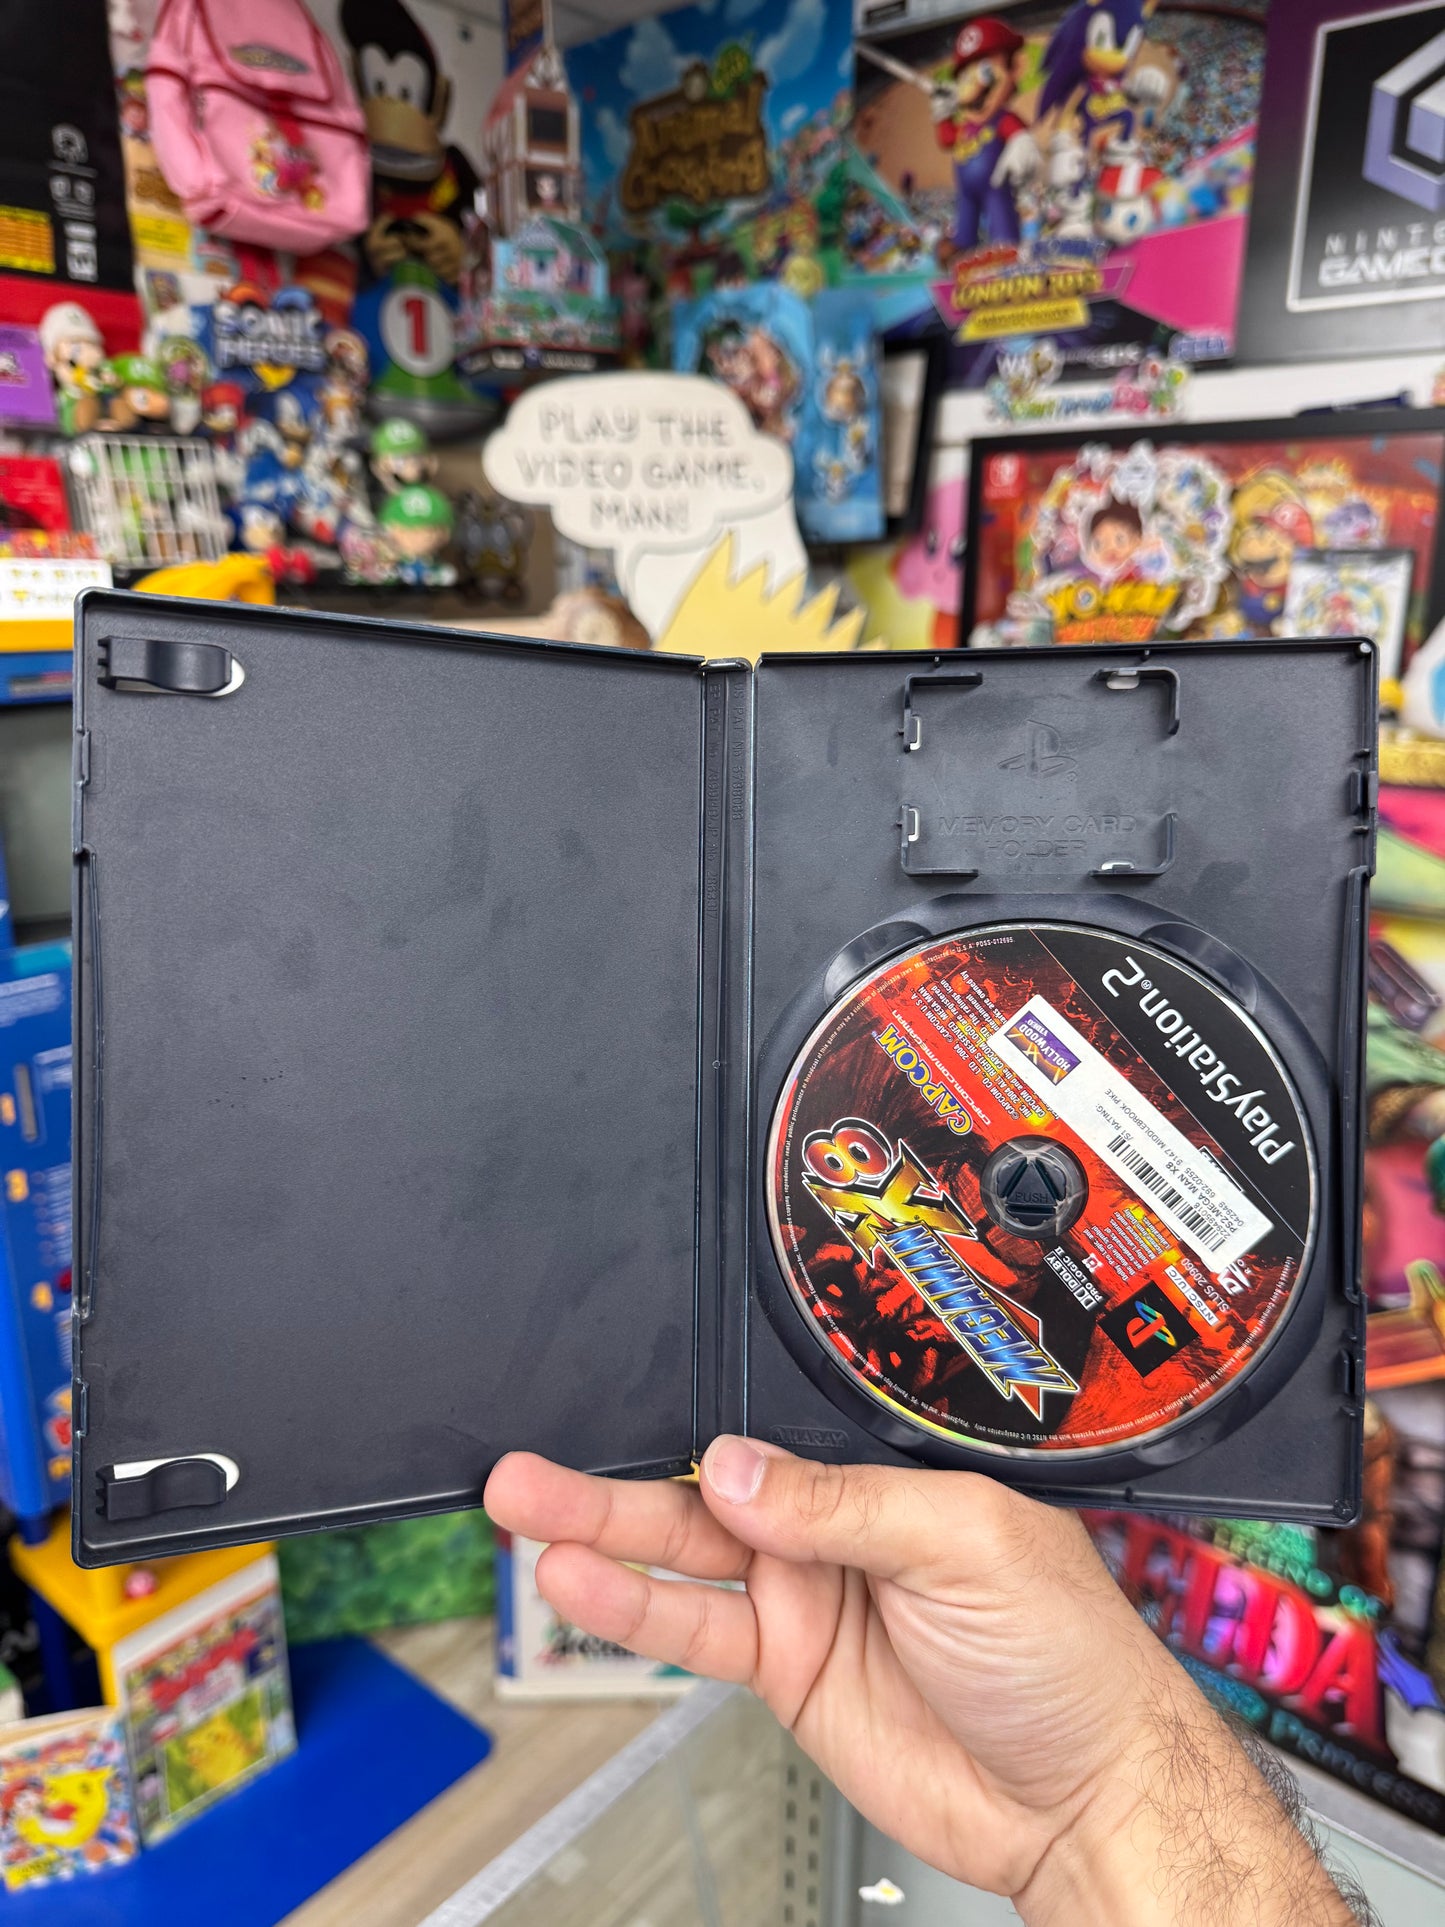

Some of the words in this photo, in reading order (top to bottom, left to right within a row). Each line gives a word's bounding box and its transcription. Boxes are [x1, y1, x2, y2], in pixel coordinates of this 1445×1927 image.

[215, 303, 326, 340] SONIC
[404, 298, 427, 356] 1
[538, 402, 640, 443] PLAY
[649, 405, 732, 446] THE
[515, 448, 632, 490] VIDEO
[732, 706, 745, 730] PAT
[937, 815, 1054, 838] MEMORY
[1064, 813, 1137, 833] CARD
[983, 839, 1089, 860] HOLDER
[959, 969, 970, 980] by
[939, 977, 954, 993] icon
[965, 977, 986, 999] owned
[851, 993, 872, 1013] violation
[930, 983, 959, 1016] registered
[950, 991, 971, 1014] ratings
[982, 996, 995, 1010] are
[930, 1000, 950, 1020] MEGA
[955, 1013, 968, 1026] are
[965, 993, 1000, 1032] ntertainment
[967, 1011, 981, 1025] The
[825, 1030, 838, 1044] game
[964, 1023, 983, 1043] LOGO
[1026, 1018, 1049, 1036] VIDEO
[979, 1040, 1005, 1069] CAPCOM
[1017, 1022, 1071, 1071] HOLLYWOOD
[803, 1057, 820, 1082] broadcast
[974, 1051, 997, 1076] RIGHTS
[1001, 1067, 1014, 1079] the
[873, 1022, 977, 1139] CAPCOM
[993, 1074, 1007, 1088] ALL
[1010, 1077, 1023, 1091] and
[790, 1088, 805, 1120] performance
[1004, 1086, 1020, 1103] 2004
[1019, 1088, 1046, 1117] CAPCOM
[1104, 1088, 1121, 1104] PIKE
[1093, 1102, 1122, 1130] RATING:
[1119, 1102, 1166, 1148] MIDDLEBROOK
[787, 1120, 795, 1137] public
[1163, 1147, 1183, 1165] 9147
[1164, 1160, 1180, 1174] X8
[1176, 1172, 1199, 1194] MAN
[1183, 1166, 1216, 1198] 692-0255
[1015, 1190, 1049, 1204] PUSH
[1112, 1210, 1128, 1226] under
[1122, 1207, 1138, 1224] Dolby
[1192, 1201, 1230, 1239] 229495018
[1195, 1191, 1238, 1233] PS2-MEGA
[1217, 1200, 1244, 1227] 042949
[1082, 1227, 1094, 1240] and
[1091, 1224, 1109, 1244] symbol
[1103, 1226, 1112, 1234] of
[1134, 1221, 1148, 1236] from
[1108, 1232, 1135, 1261] trademarks
[1125, 1225, 1156, 1259] Manufactured
[1145, 1234, 1163, 1254] license
[1104, 1253, 1115, 1265] Pro
[1132, 1259, 1142, 1270] are
[1134, 1247, 1150, 1264] Dolby
[1046, 1253, 1078, 1288] DOLBY
[1062, 1254, 1087, 1282] LOGIC
[1125, 1264, 1136, 1275] the
[1180, 1256, 1207, 1285] 20960
[1167, 1268, 1187, 1289] U/C
[1084, 1281, 1102, 1301] PRO
[1202, 1283, 1229, 1312] SLUS
[1187, 1292, 1214, 1321] NTSC
[855, 1352, 877, 1373] registered
[1133, 1410, 1159, 1425] computer
[986, 1426, 1019, 1438] designation
[1071, 1430, 1095, 1439] systems
